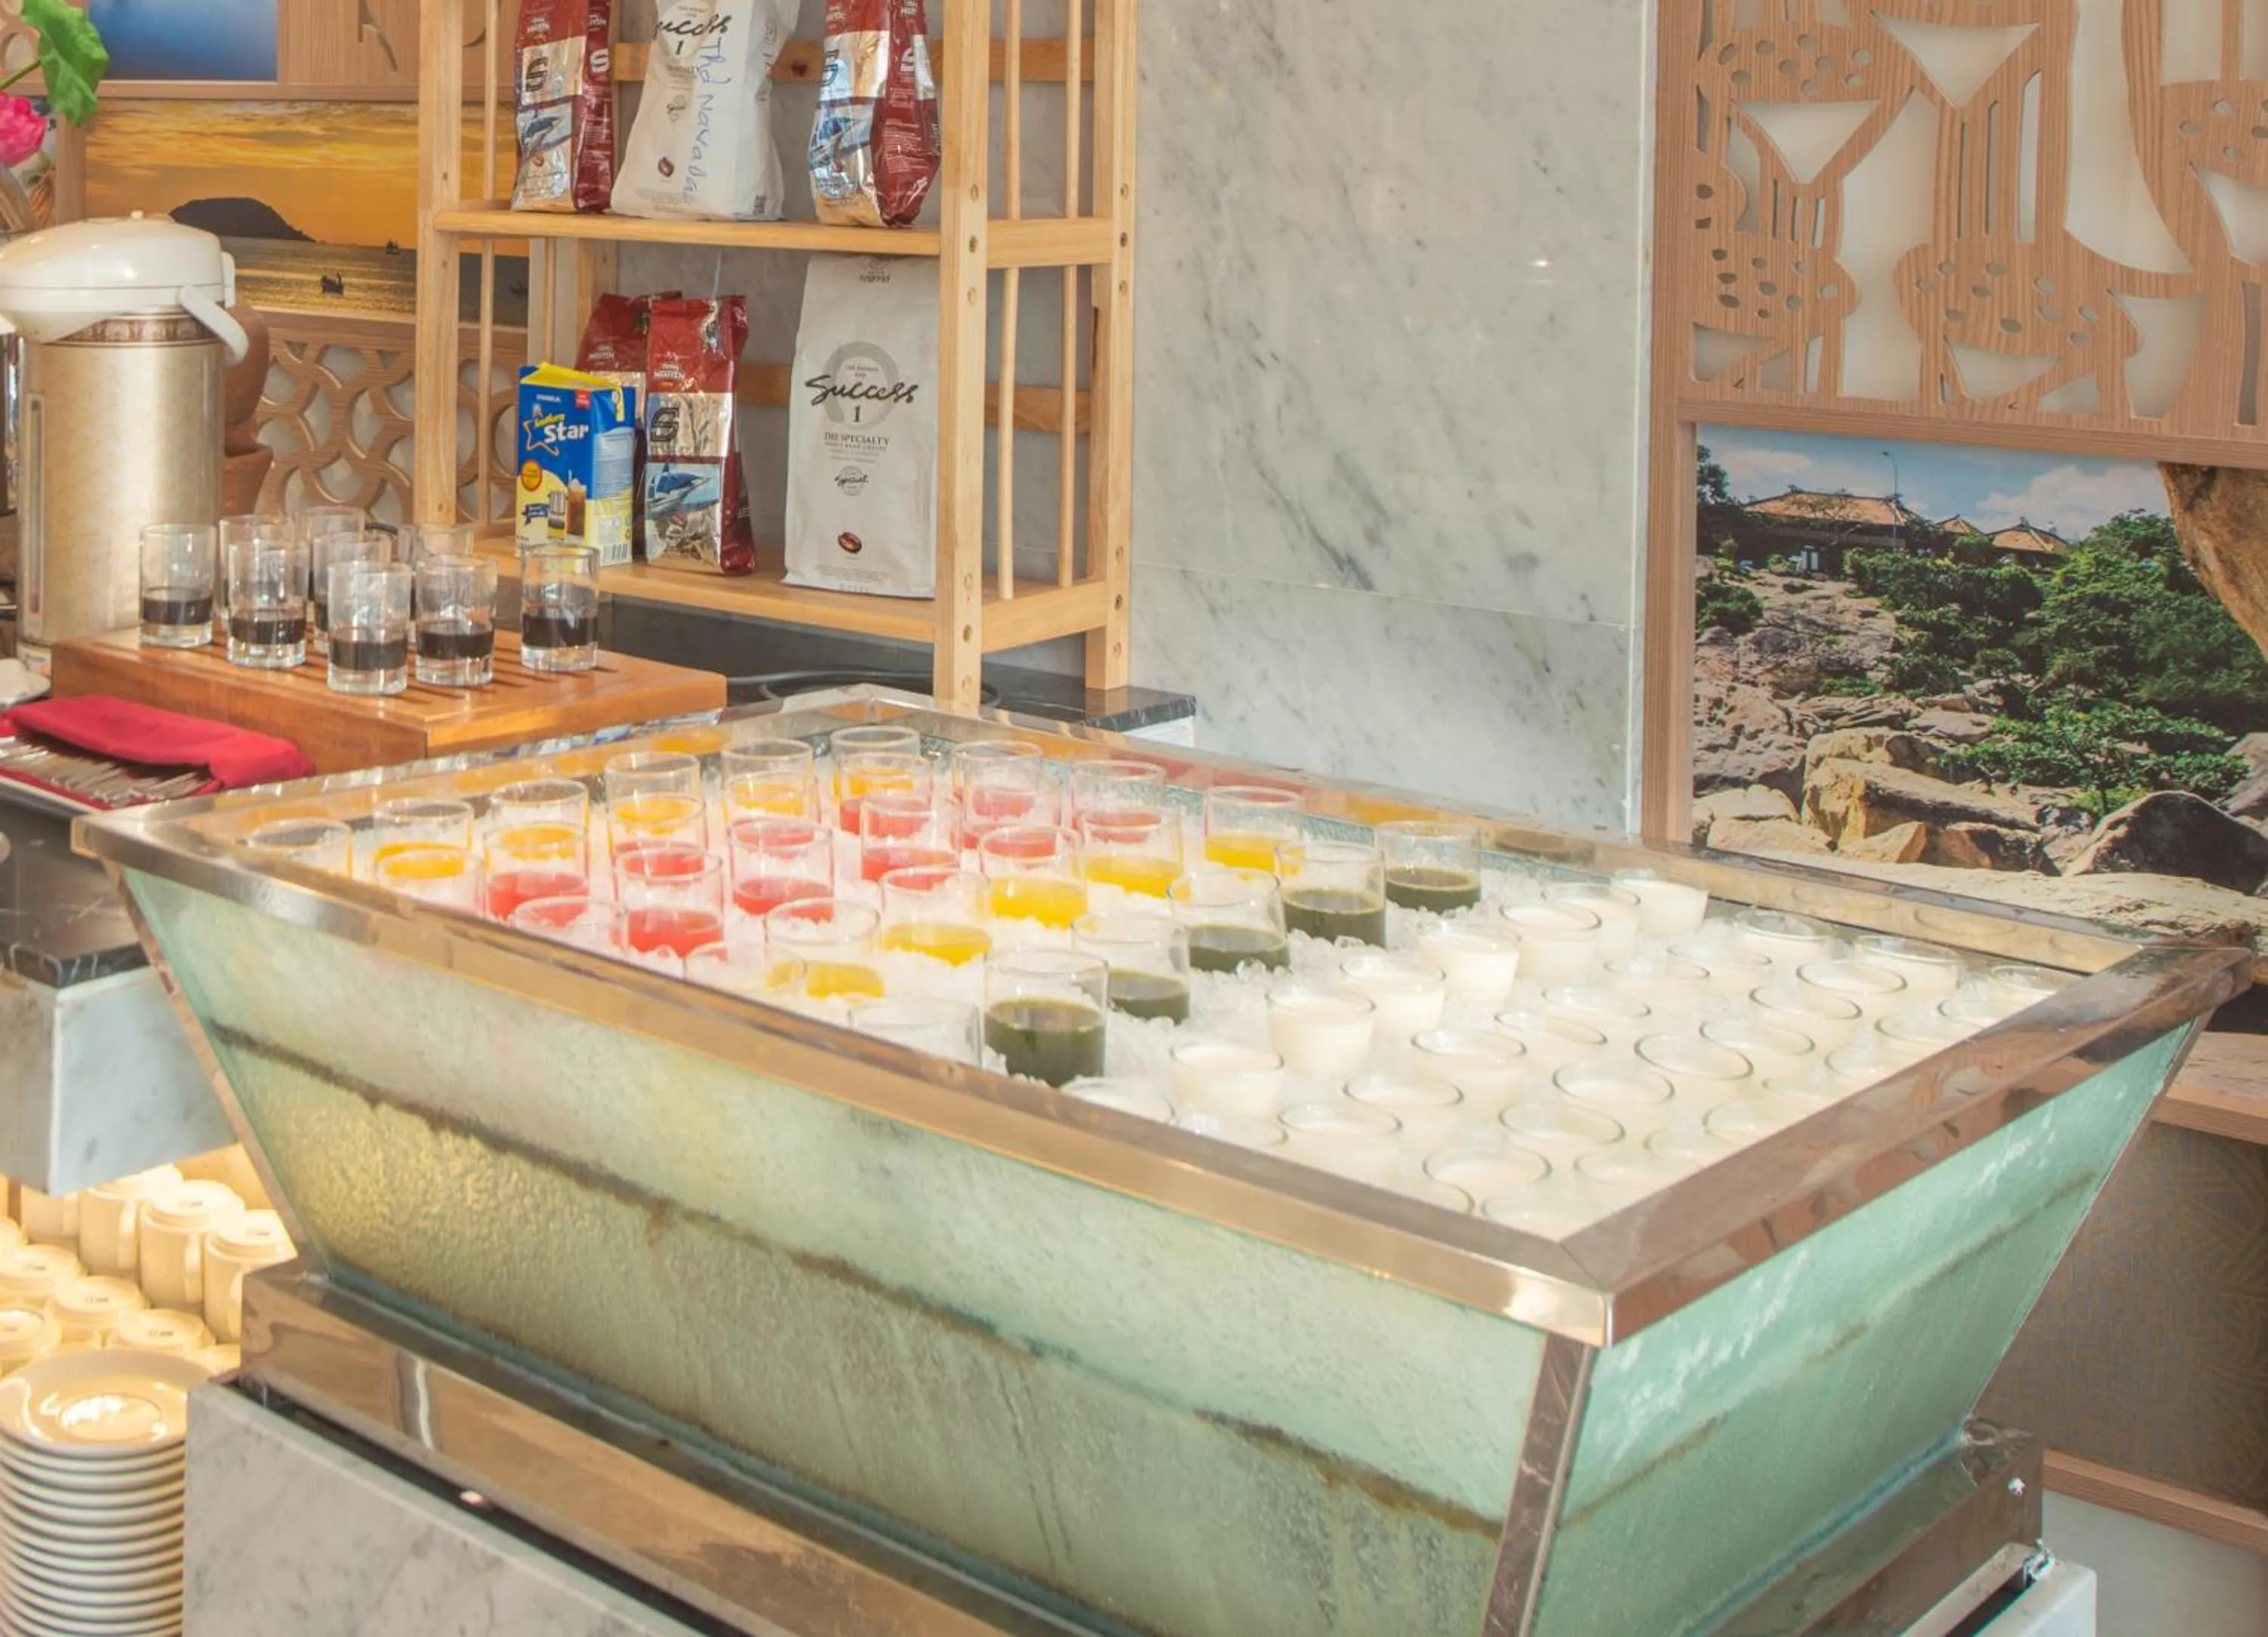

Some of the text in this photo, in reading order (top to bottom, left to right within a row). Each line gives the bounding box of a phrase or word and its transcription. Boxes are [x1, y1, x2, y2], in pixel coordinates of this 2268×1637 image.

[804, 374, 919, 407] Success
[854, 404, 861, 422] 1
[544, 422, 590, 444] Star
